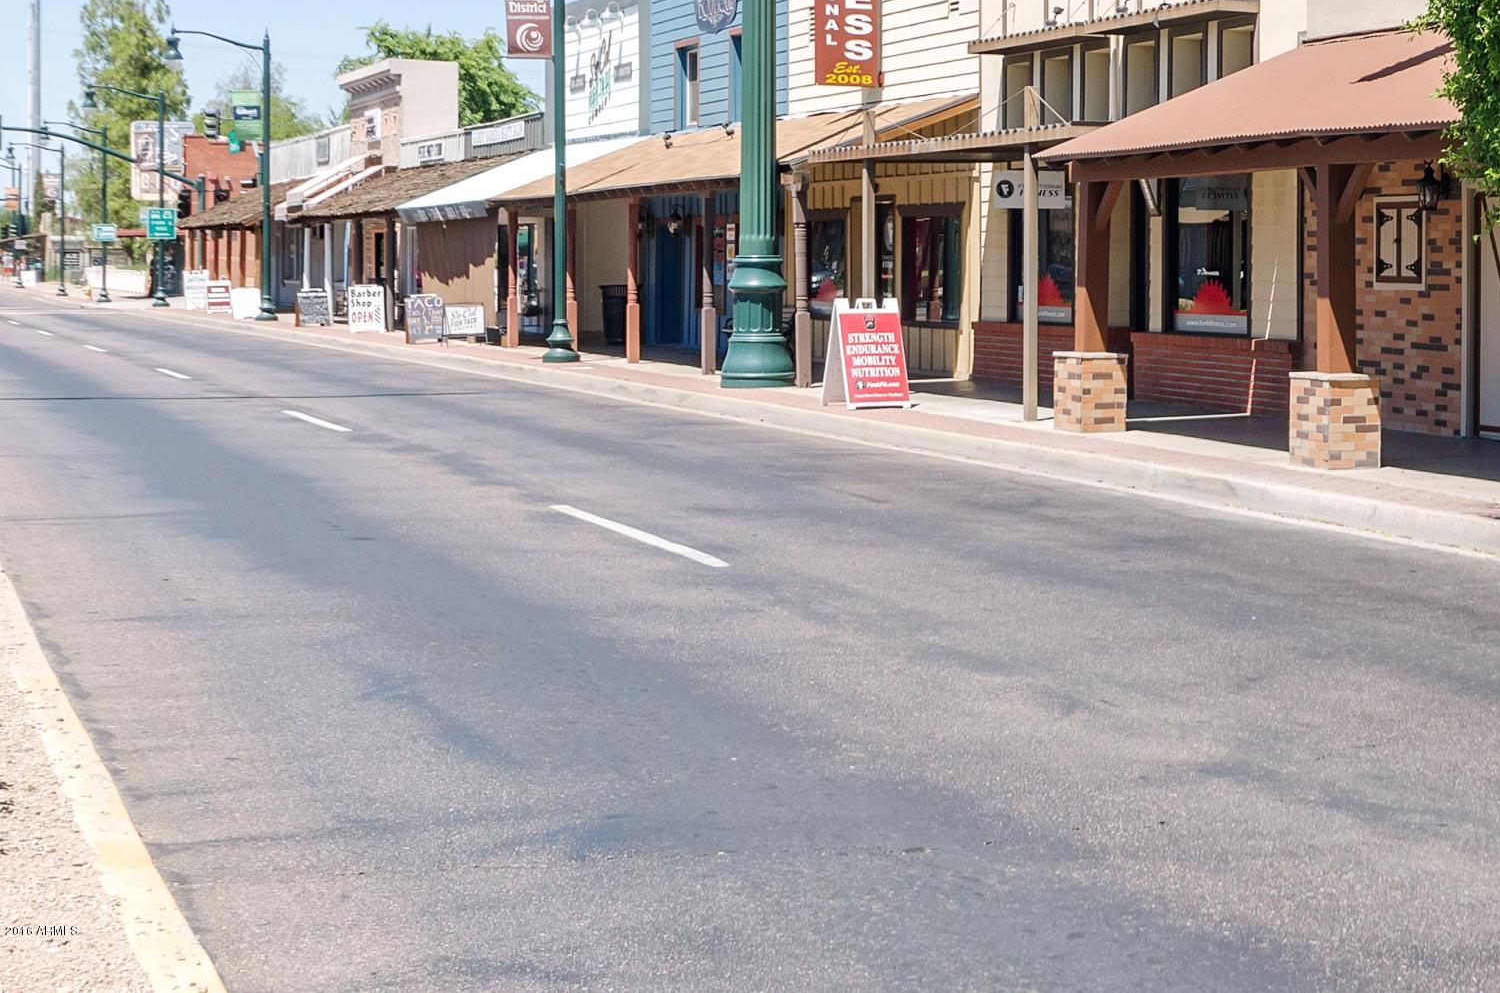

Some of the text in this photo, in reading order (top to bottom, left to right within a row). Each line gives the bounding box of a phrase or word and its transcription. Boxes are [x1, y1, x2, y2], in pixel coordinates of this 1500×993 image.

[509, 2, 547, 13] District
[825, 73, 873, 84] 2008
[351, 290, 381, 298] Barber
[351, 299, 372, 308] Shop
[403, 297, 443, 309] TACO
[351, 311, 374, 323] OPEN
[848, 332, 896, 343] STRENGTH
[846, 344, 900, 355] ENDURANCE
[852, 355, 896, 366] MOBILITY
[851, 367, 900, 378] NUTRITION
